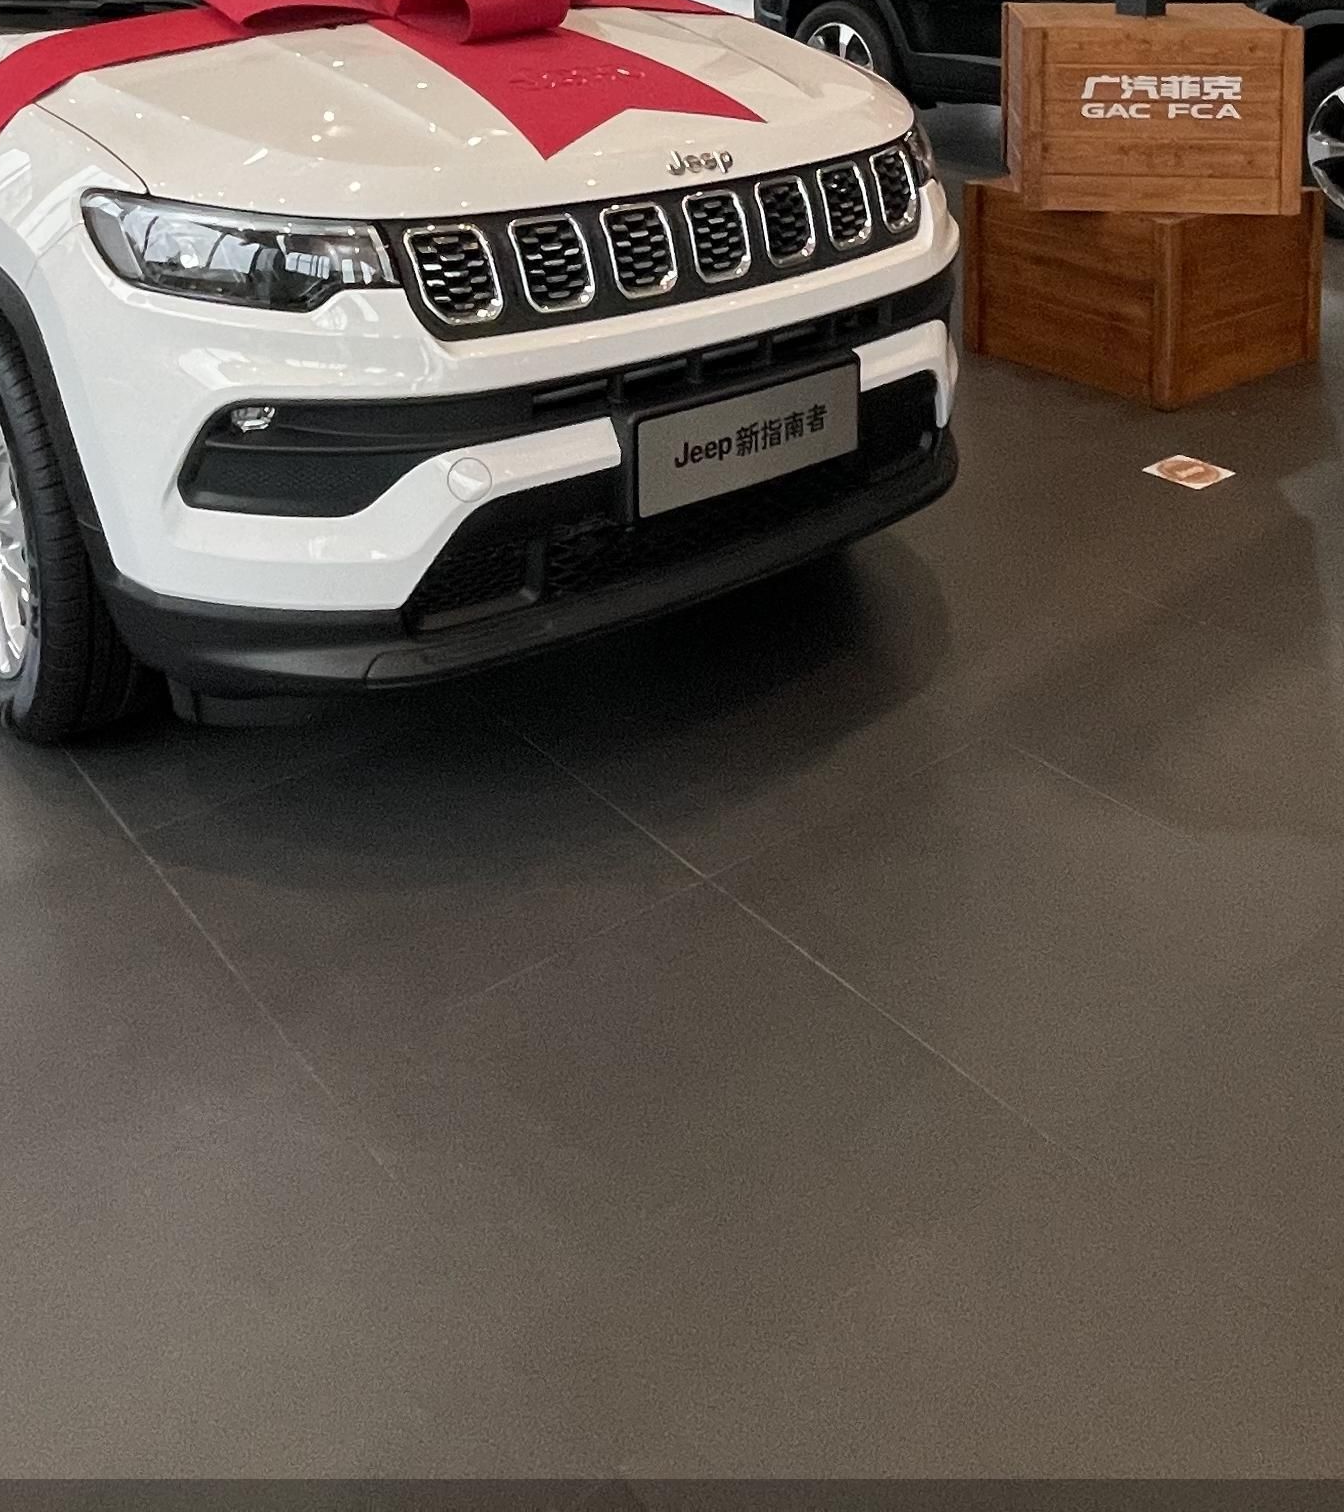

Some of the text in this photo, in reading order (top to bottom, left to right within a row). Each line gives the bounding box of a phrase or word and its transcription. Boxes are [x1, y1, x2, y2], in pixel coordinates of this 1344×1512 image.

[1081, 75, 1243, 100] 广汽菲克
[1081, 102, 1243, 119] GAC FCA
[665, 149, 734, 176] Jeep
